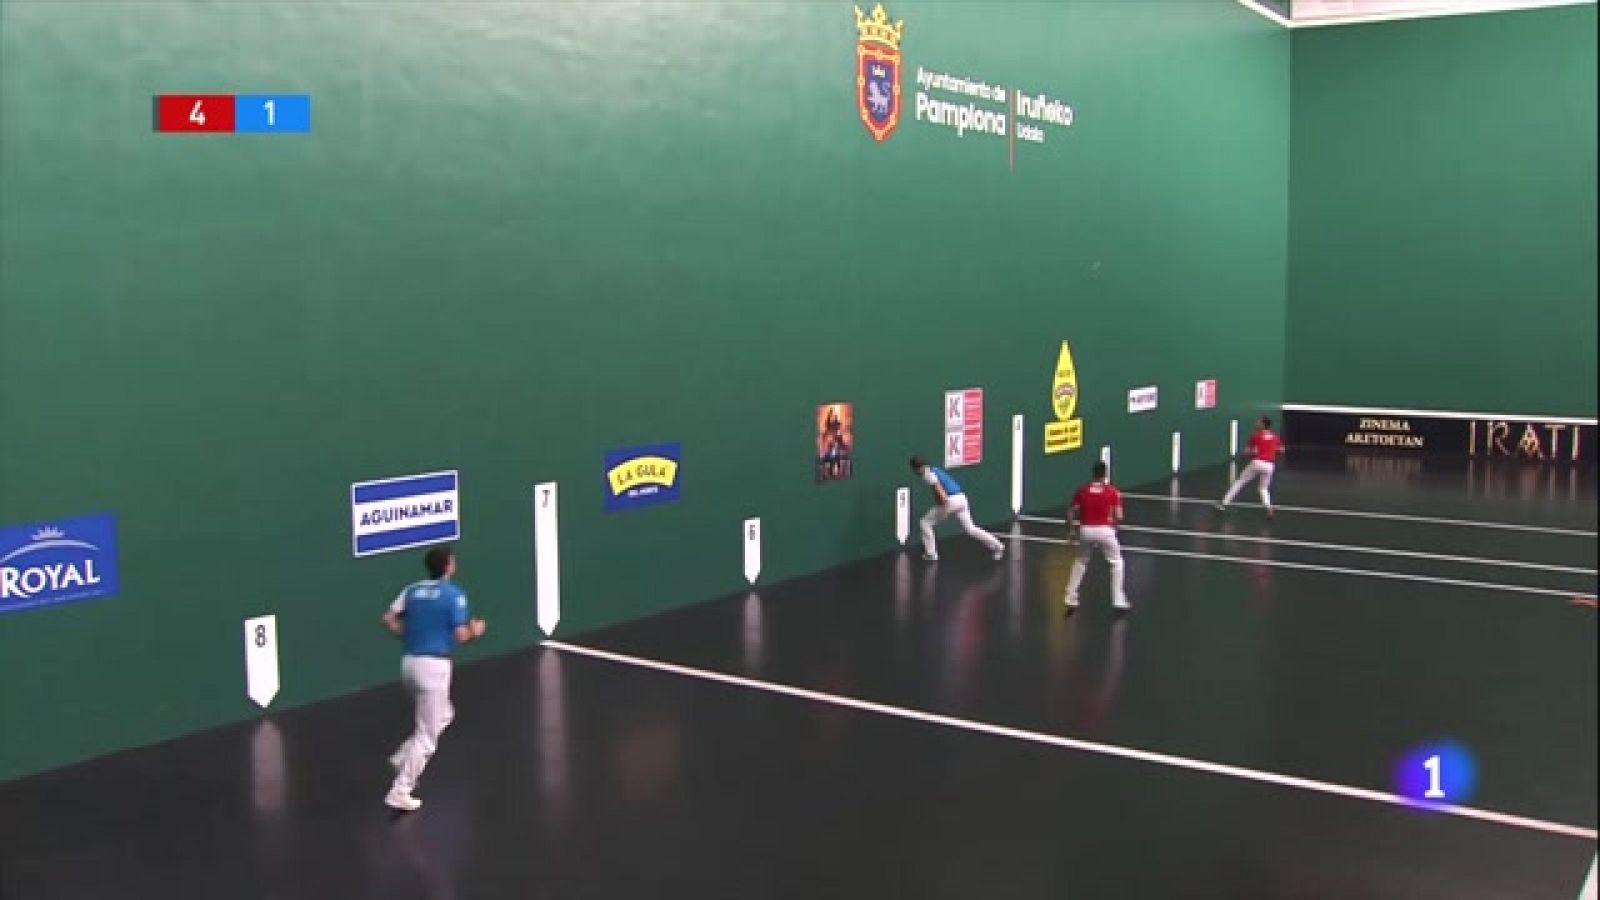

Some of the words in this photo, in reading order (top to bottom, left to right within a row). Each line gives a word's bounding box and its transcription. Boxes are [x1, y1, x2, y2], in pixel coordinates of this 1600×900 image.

[915, 91, 1006, 138] Pamplona
[1469, 419, 1581, 461] IRATI
[614, 464, 633, 486] LA
[358, 498, 455, 528] AGUINAMAR
[541, 489, 551, 509] 7
[0, 558, 101, 599] ROYAL
[254, 623, 269, 649] 8
